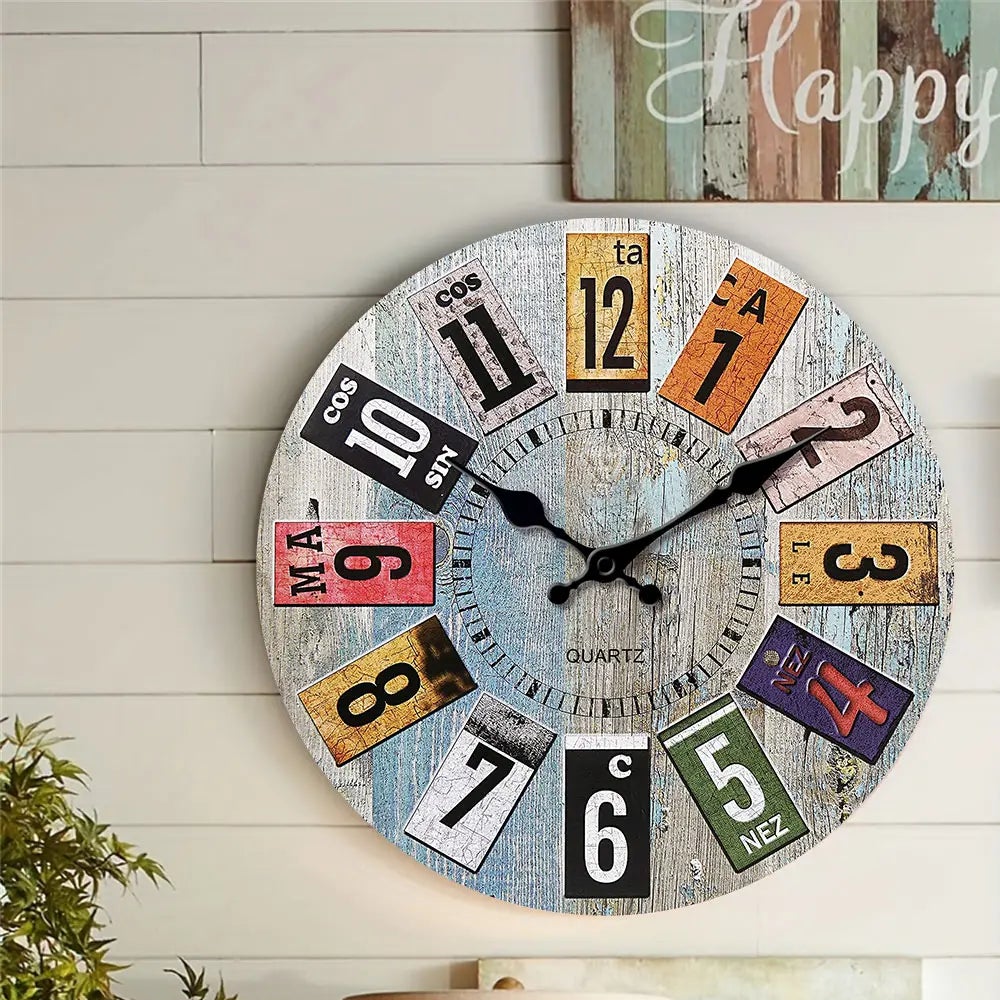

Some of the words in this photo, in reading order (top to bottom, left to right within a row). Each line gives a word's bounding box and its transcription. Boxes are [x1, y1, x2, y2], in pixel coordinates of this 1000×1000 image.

[613, 240, 643, 265] ta
[437, 303, 537, 414] 11
[579, 275, 635, 370] 12
[693, 329, 744, 405] 1
[344, 398, 431, 480] 10
[425, 444, 459, 490] SIN
[789, 396, 881, 469] 2
[334, 545, 412, 582] 9
[823, 543, 909, 582] 3
[566, 648, 645, 665] QUARTZ
[772, 644, 813, 694] NEZ
[336, 662, 421, 728] 8
[808, 660, 889, 738] 4
[439, 743, 516, 830] 7
[695, 732, 766, 823] 5
[584, 790, 630, 884] 6
[739, 811, 790, 855] NEZ
